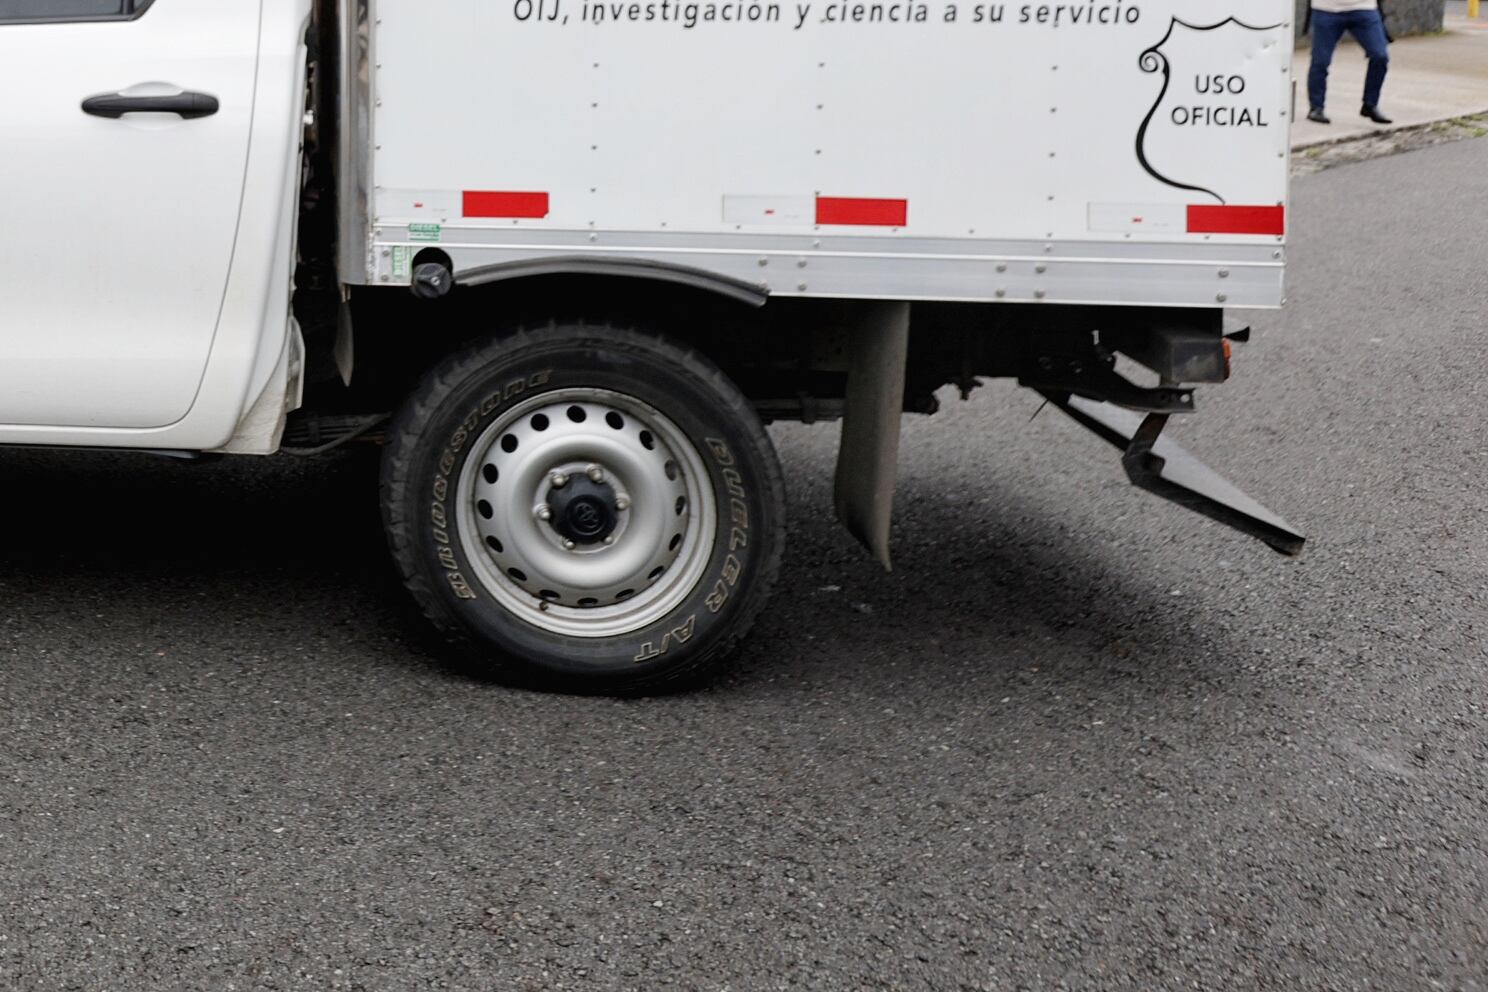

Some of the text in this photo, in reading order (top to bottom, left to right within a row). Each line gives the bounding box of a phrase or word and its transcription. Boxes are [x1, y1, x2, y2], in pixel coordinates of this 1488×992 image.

[794, 5, 811, 30] y
[943, 5, 958, 23] a
[973, 5, 1004, 24] su
[1194, 74, 1246, 96] USO
[1170, 105, 1269, 128] OFICIAL
[428, 369, 552, 601] BRIDGESTONE
[703, 435, 752, 614] DUELER
[633, 613, 699, 663] A/T
